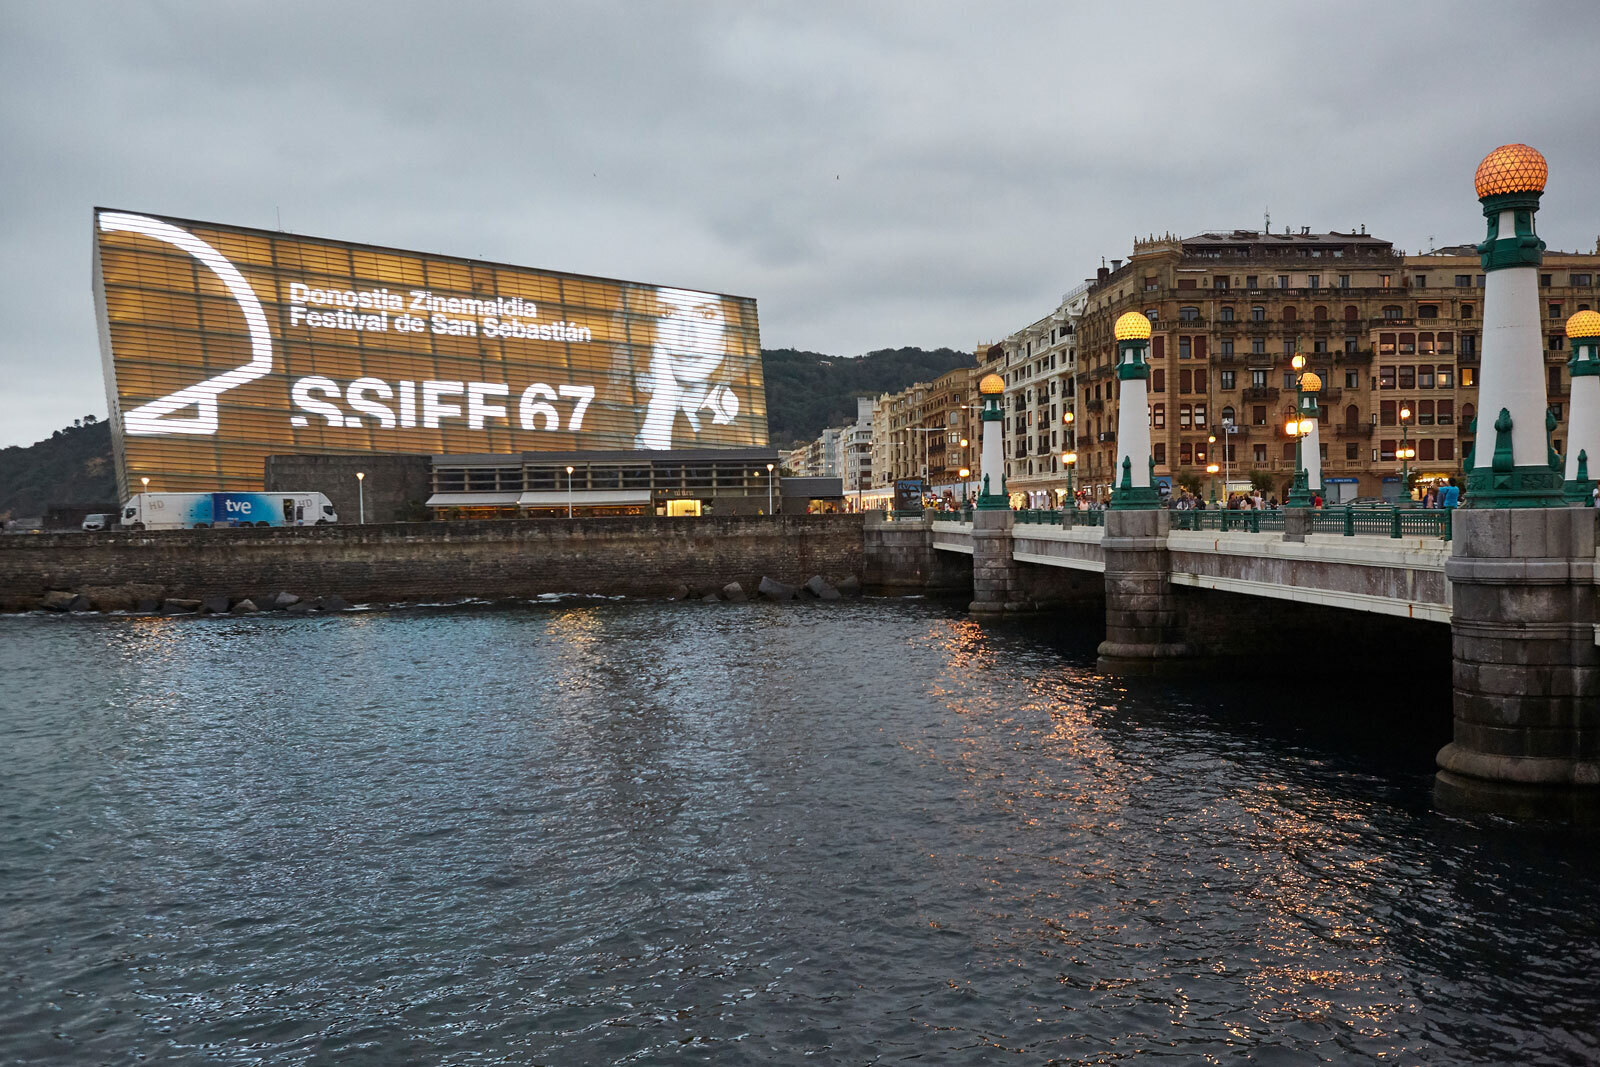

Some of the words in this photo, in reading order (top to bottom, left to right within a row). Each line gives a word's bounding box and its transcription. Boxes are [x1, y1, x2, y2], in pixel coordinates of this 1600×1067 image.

[290, 282, 403, 310] Donostia
[409, 290, 537, 318] Zinemaldia
[290, 306, 387, 332] Festival
[394, 313, 425, 333] de
[431, 314, 477, 336] San
[483, 317, 592, 343] Sebastián
[290, 375, 509, 429] SSIFF
[519, 383, 595, 431] 67
[149, 500, 165, 510] HD
[225, 499, 252, 514] tve
